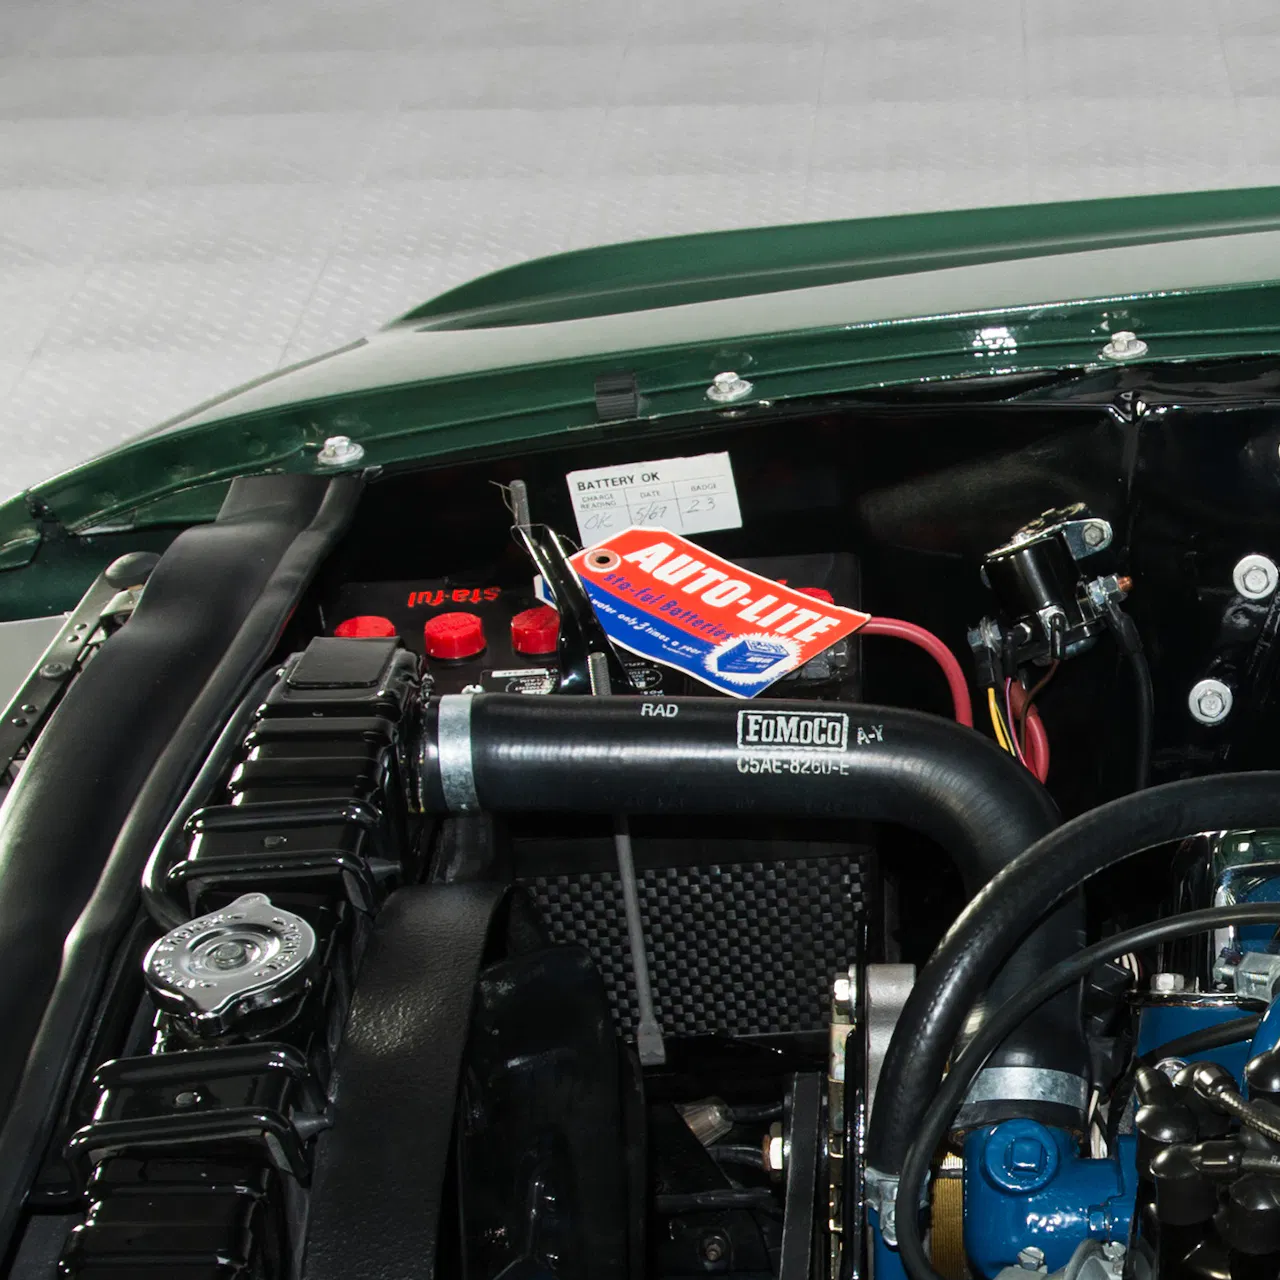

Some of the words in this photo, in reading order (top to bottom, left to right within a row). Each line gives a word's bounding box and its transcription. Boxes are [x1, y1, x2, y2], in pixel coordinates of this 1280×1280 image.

[577, 475, 635, 492] BATTERY
[641, 472, 660, 483] OK
[690, 483, 717, 492] BADGE
[581, 493, 614, 503] CHARGE
[639, 490, 660, 499] DATE
[580, 500, 616, 510] READING
[622, 541, 841, 643] AUTO-LITE
[617, 612, 639, 626] only
[645, 627, 670, 643] times
[640, 703, 679, 718] RAD
